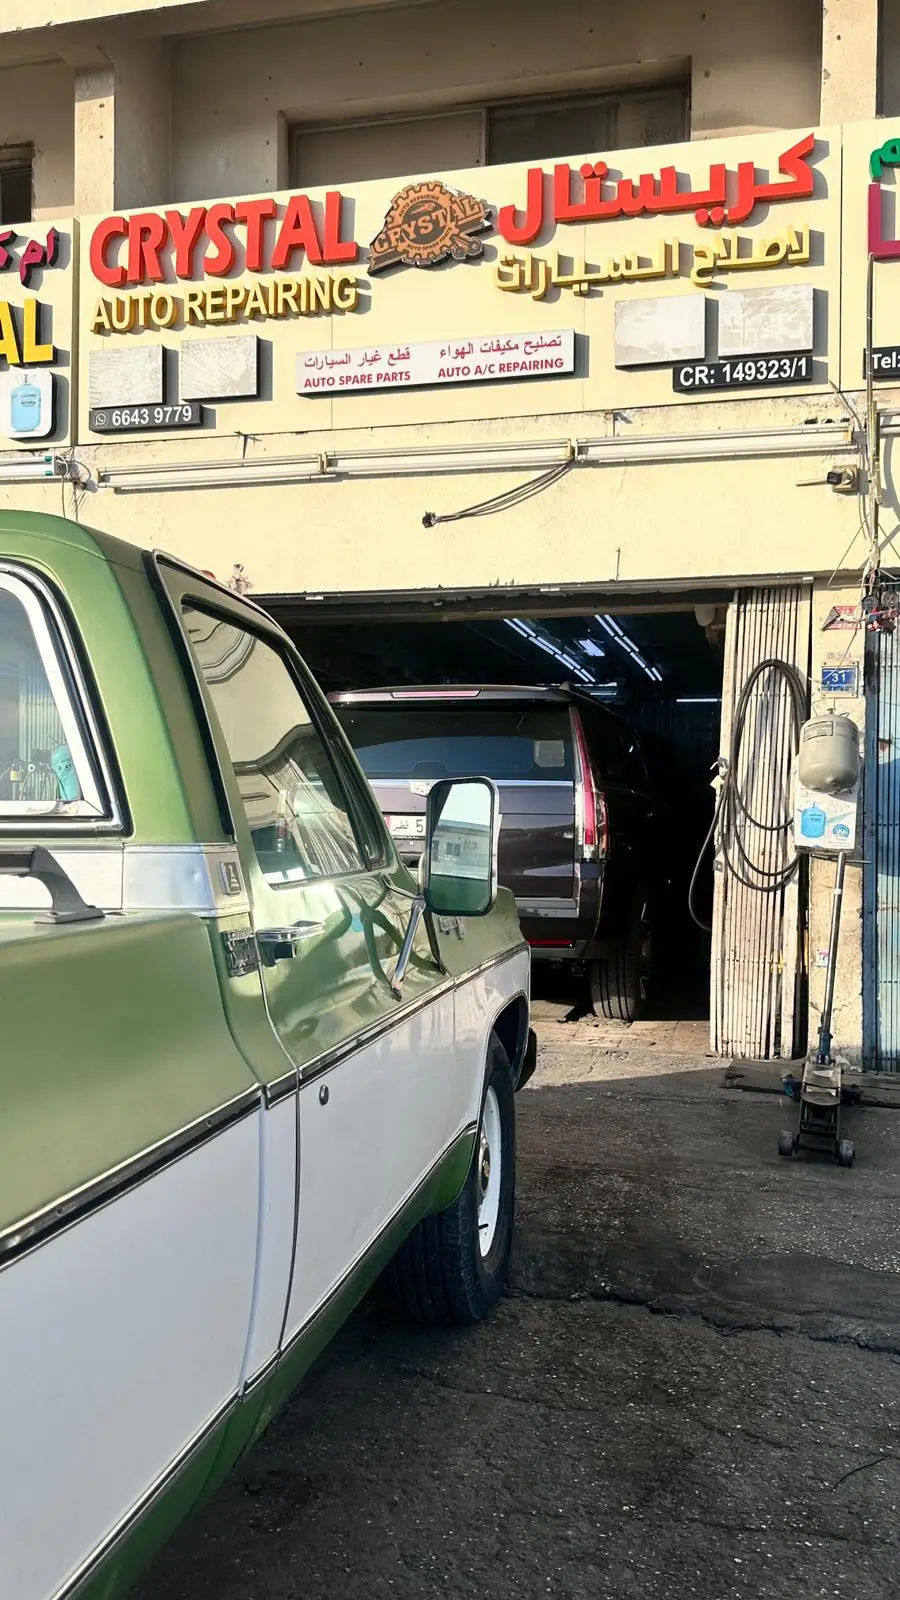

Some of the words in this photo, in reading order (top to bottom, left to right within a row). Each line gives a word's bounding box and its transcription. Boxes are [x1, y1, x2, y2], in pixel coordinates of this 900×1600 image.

[498, 132, 815, 246] كريستال
[90, 191, 358, 288] CRYSTAL
[494, 234, 680, 301] السيارات
[91, 289, 177, 332] AUTO
[184, 273, 358, 323] REPAIRING
[439, 342, 474, 359] الهواء
[480, 339, 519, 356] مكيفات
[523, 335, 562, 355] تصليح
[304, 353, 351, 370] السيارات
[357, 350, 382, 366] غيار
[387, 347, 411, 366] قطع
[438, 365, 470, 378] AUTO
[474, 363, 495, 376] A/C
[499, 358, 564, 373] REPAIRING
[679, 365, 715, 386] CR:
[722, 357, 807, 383] 149323/1
[304, 376, 335, 388] AUTO
[339, 373, 373, 386] SPARE
[376, 371, 411, 383] PARTS
[112, 408, 150, 426] 6643
[154, 405, 192, 424] 9779
[832, 673, 846, 683] 31
